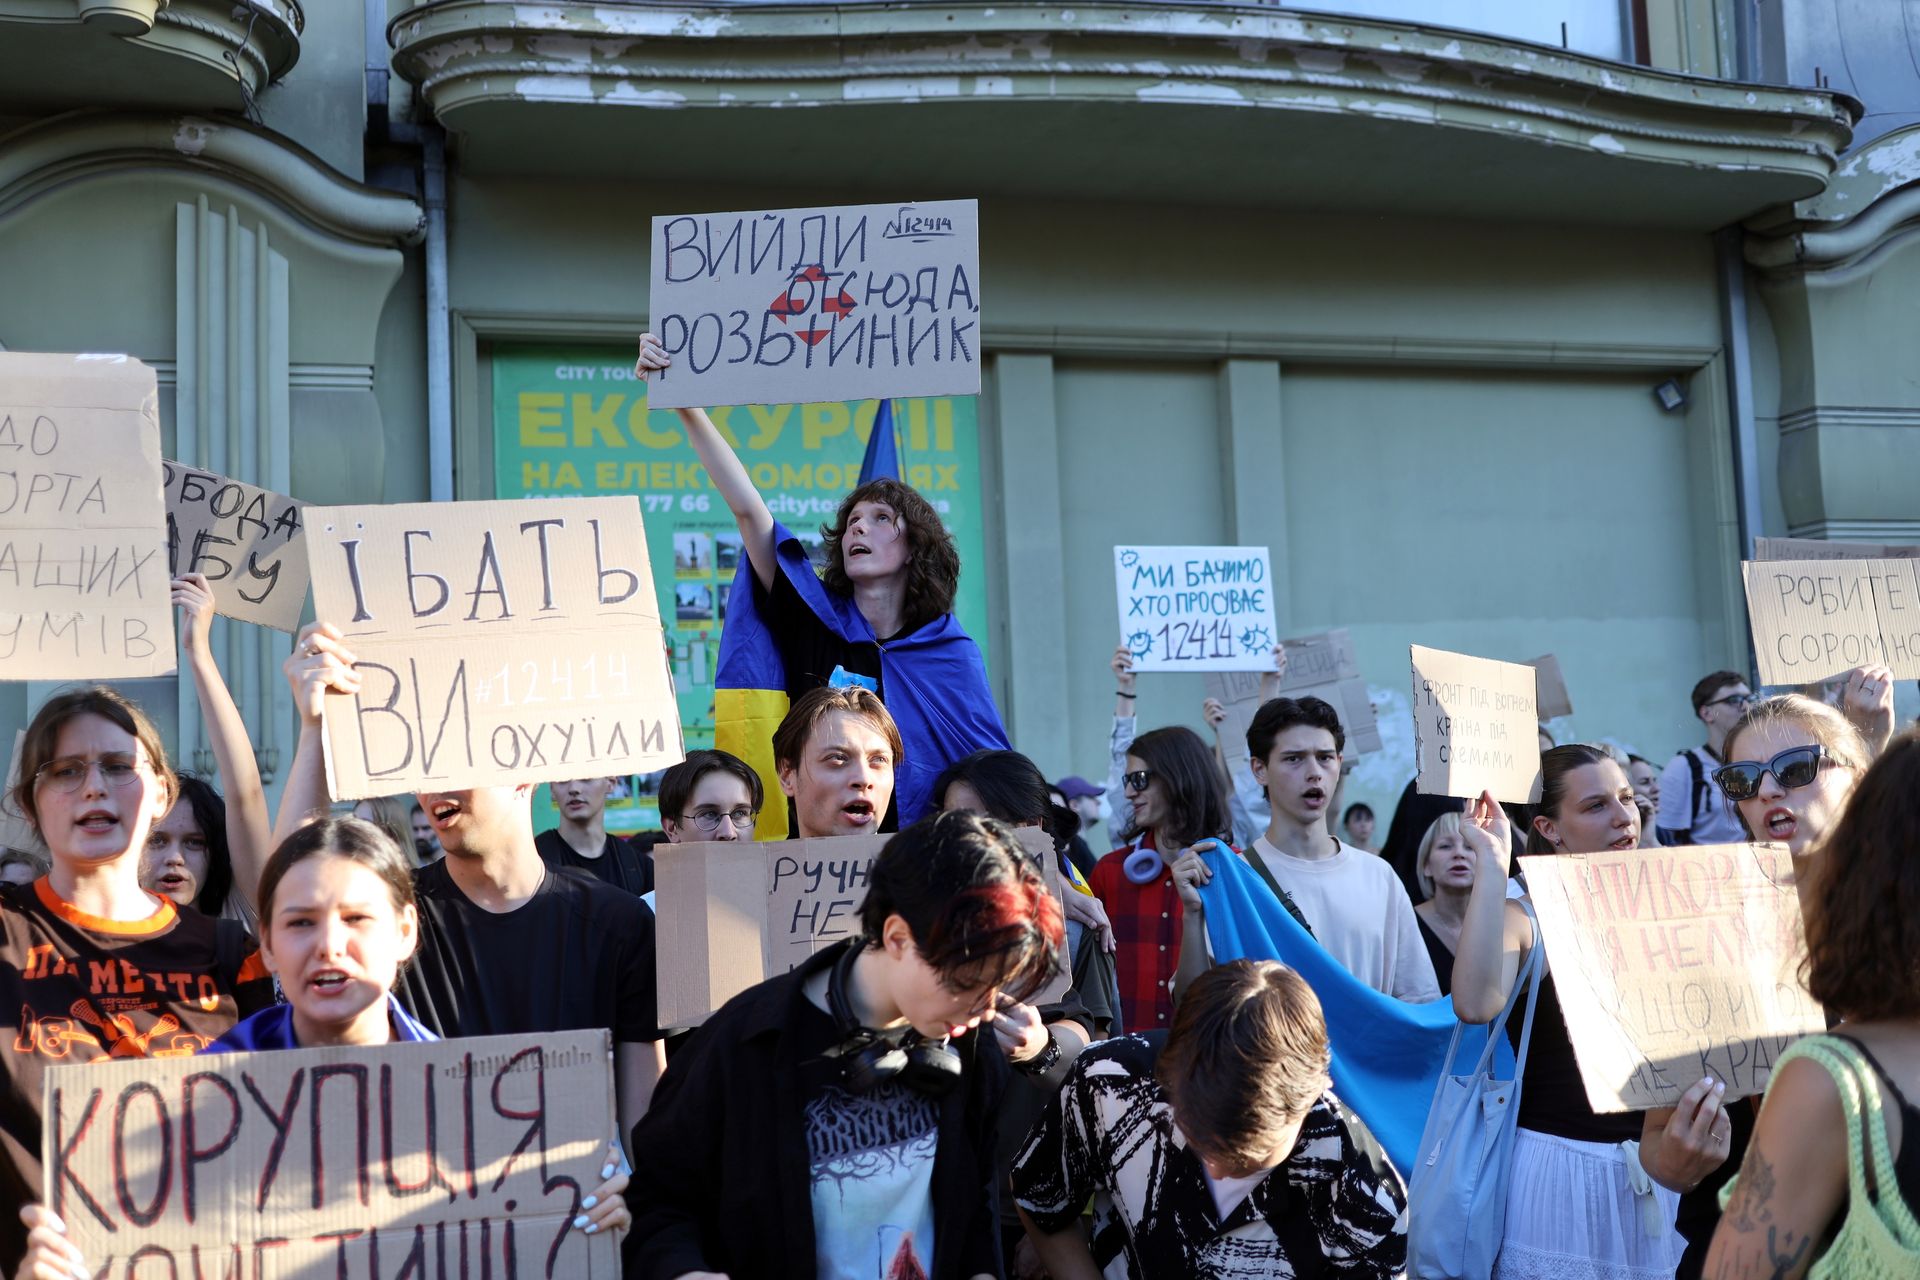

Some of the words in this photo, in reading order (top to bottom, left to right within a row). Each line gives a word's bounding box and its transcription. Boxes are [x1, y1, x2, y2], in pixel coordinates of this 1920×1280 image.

[664, 214, 868, 284] ВИЙДИ
[787, 264, 979, 316] ОТСЮДА,
[555, 366, 596, 381] CITY
[601, 367, 638, 382] TOU
[522, 461, 583, 490] НА
[644, 495, 673, 512] 77
[680, 494, 711, 513] 66
[1132, 564, 1174, 590] МИ
[1185, 557, 1264, 588] БАЧИМО
[1128, 594, 1170, 616] ХТО
[1176, 588, 1266, 616] ПРОСУВАЄ
[1773, 573, 1905, 617] РОБИТЕ
[1156, 617, 1237, 661] 12414
[473, 652, 633, 706] #12414
[1422, 679, 1464, 707] ФРОНТ
[351, 657, 474, 777] ВИ
[1436, 715, 1481, 738] КРАЇНА
[773, 856, 873, 893] РУЧН
[790, 899, 854, 937] НЕ
[52, 1046, 547, 1233] КОРУПЦІЯ
